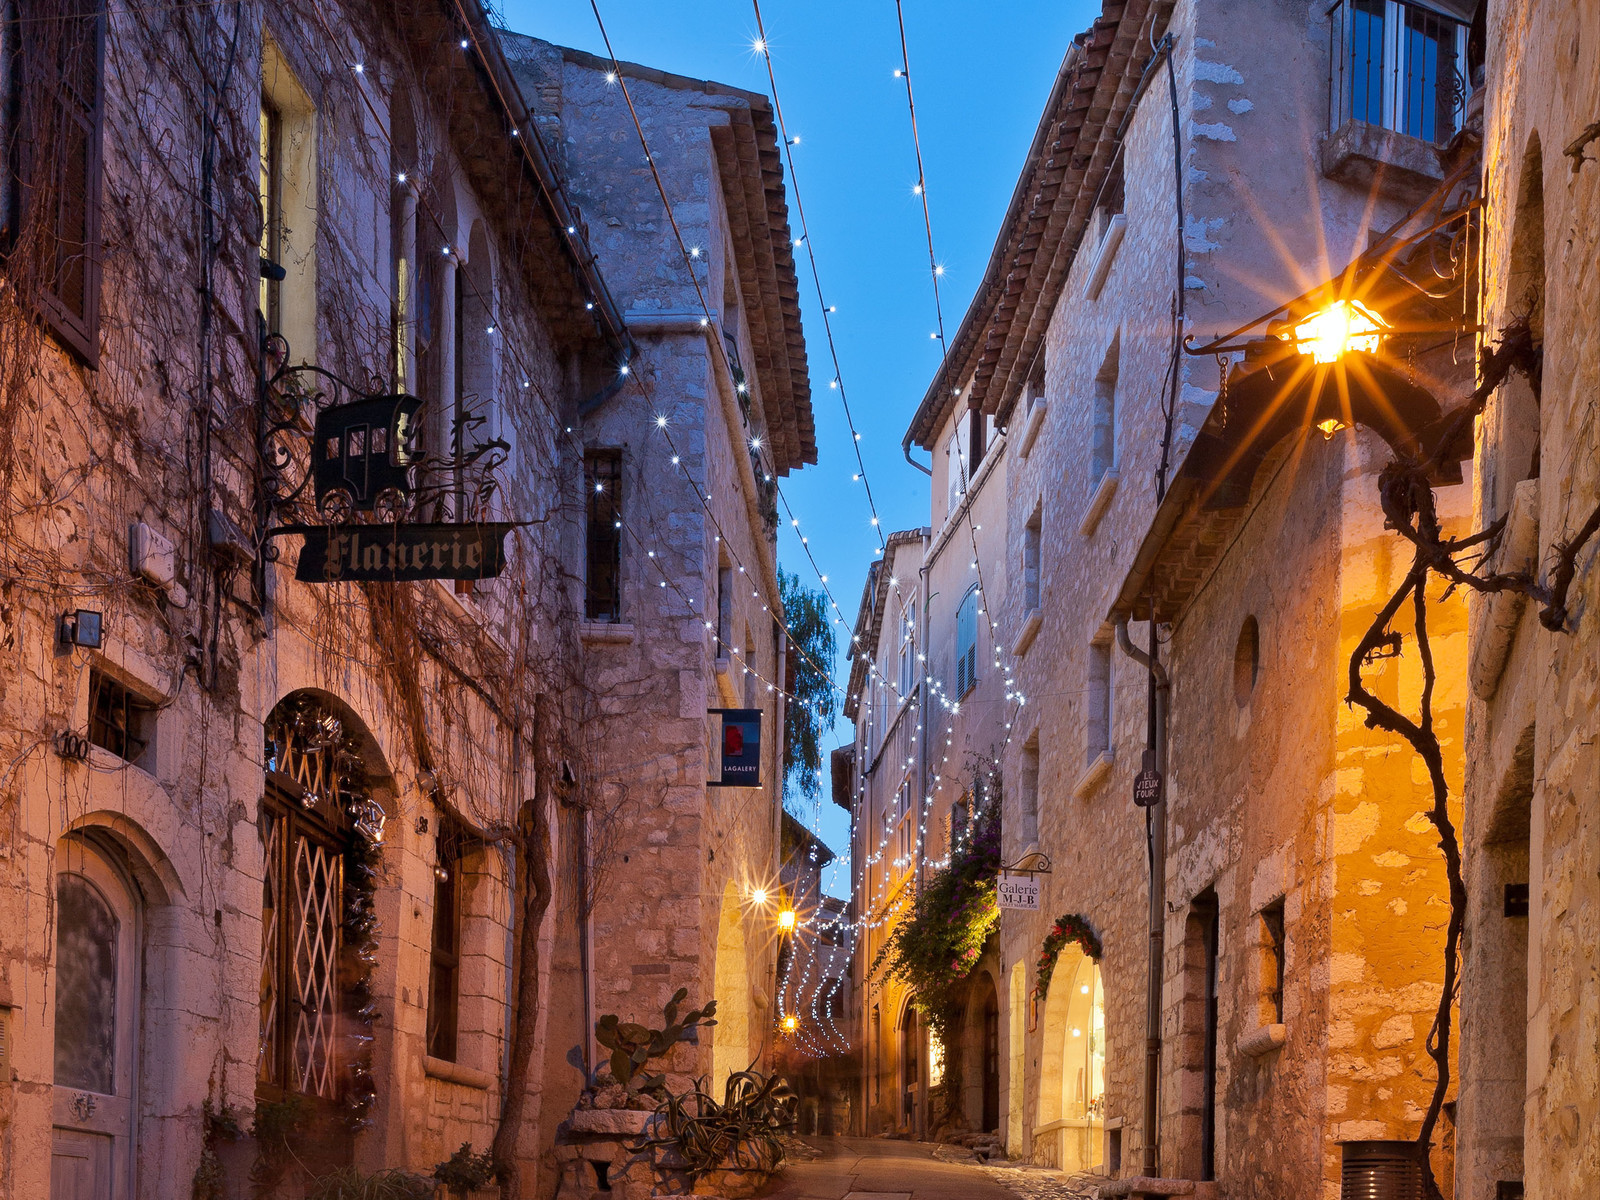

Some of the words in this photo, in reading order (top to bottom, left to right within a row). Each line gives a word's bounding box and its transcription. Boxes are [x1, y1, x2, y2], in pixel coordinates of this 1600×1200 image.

[323, 531, 483, 581] Flanerie
[60, 731, 88, 760] 100
[1143, 771, 1153, 780] LE
[1136, 780, 1159, 790] VIEUX
[998, 882, 1038, 895] Galerie
[1003, 894, 1035, 904] M-J-B
